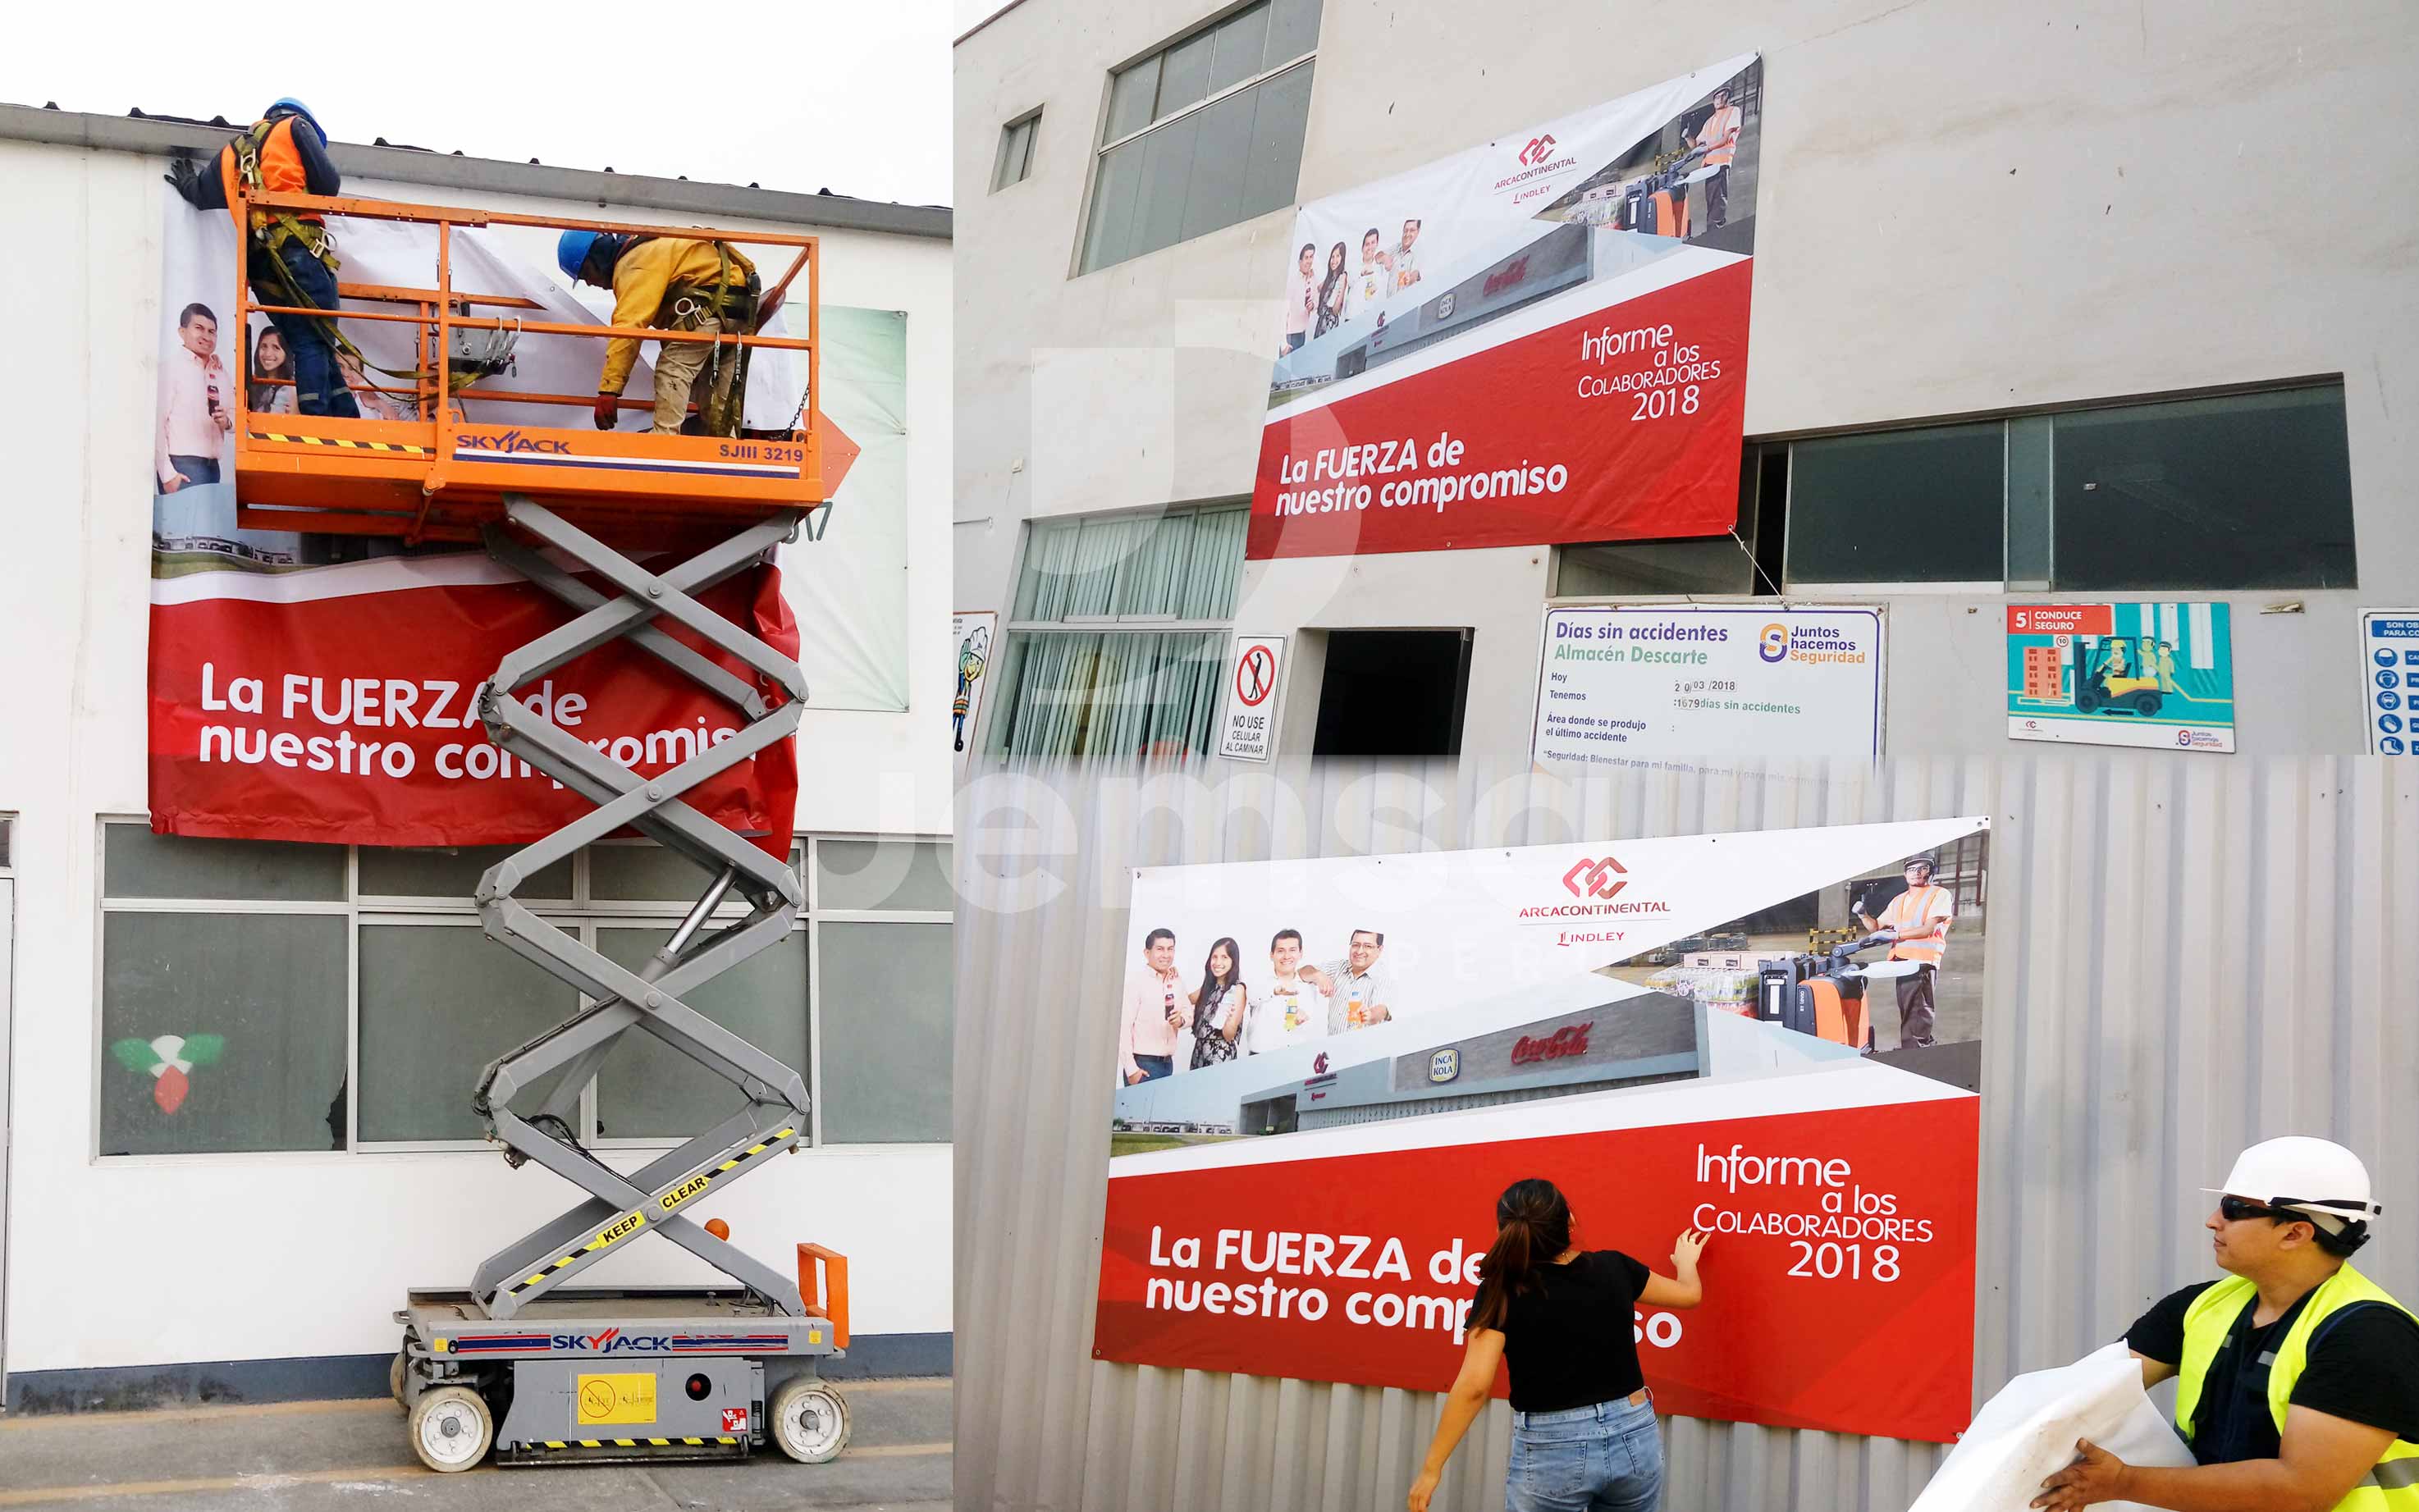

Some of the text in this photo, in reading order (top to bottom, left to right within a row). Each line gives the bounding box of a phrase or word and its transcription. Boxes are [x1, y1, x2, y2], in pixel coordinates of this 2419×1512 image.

[1493, 158, 1576, 190] ARCACONTINENTAL
[1581, 324, 1673, 365] Informe
[1654, 341, 1699, 367] a los
[1578, 360, 1721, 398] COLABORADORES
[1631, 385, 1699, 421] 2018
[456, 430, 571, 454] SKYJACK
[763, 445, 804, 463] 3219
[1280, 432, 1465, 485] La FUERZA de
[1275, 459, 1568, 516] nuestro compromiso
[1790, 626, 1840, 637] Juntos
[2015, 611, 2082, 628] 5 CONDUCE
[2035, 621, 2074, 630] SEGURO
[1556, 622, 1728, 642] Días sin accidentes
[1554, 644, 1708, 665] Almacén Descarte
[1790, 638, 1856, 651] hacemos
[1790, 649, 1865, 665] Seguridad
[1551, 672, 1567, 683] Hoy
[201, 662, 263, 715] La
[523, 680, 588, 727] de
[1549, 690, 1586, 701] Tenemos
[1723, 700, 1740, 710] sin
[1742, 701, 1800, 714] accidentes
[1232, 715, 1264, 729] NO USE
[1568, 715, 1595, 726] donde
[1598, 719, 1608, 727] se
[1611, 719, 1646, 731] produjo
[1232, 730, 1260, 742] CELULAR
[1546, 728, 1553, 736] el
[1584, 730, 1627, 742] accidente
[199, 725, 416, 779] nuestro
[1226, 742, 1264, 754] AL CAMINAR
[1520, 902, 1671, 918] ARCACONTINENTAL
[1557, 932, 1625, 946] LINDLEY
[1433, 1066, 1453, 1076] KOLA
[1435, 1056, 1453, 1065] INCA
[1696, 1143, 1851, 1193] Informe
[603, 1176, 706, 1243] KEEP CLEAR
[1821, 1185, 1897, 1216] a los
[1693, 1203, 1933, 1242] COLABORADORES
[1150, 1225, 1487, 1286] La FUERZA de
[1787, 1240, 1900, 1282] 2018
[1145, 1277, 1328, 1321] nuestro
[552, 1327, 671, 1354] SKYJACK
